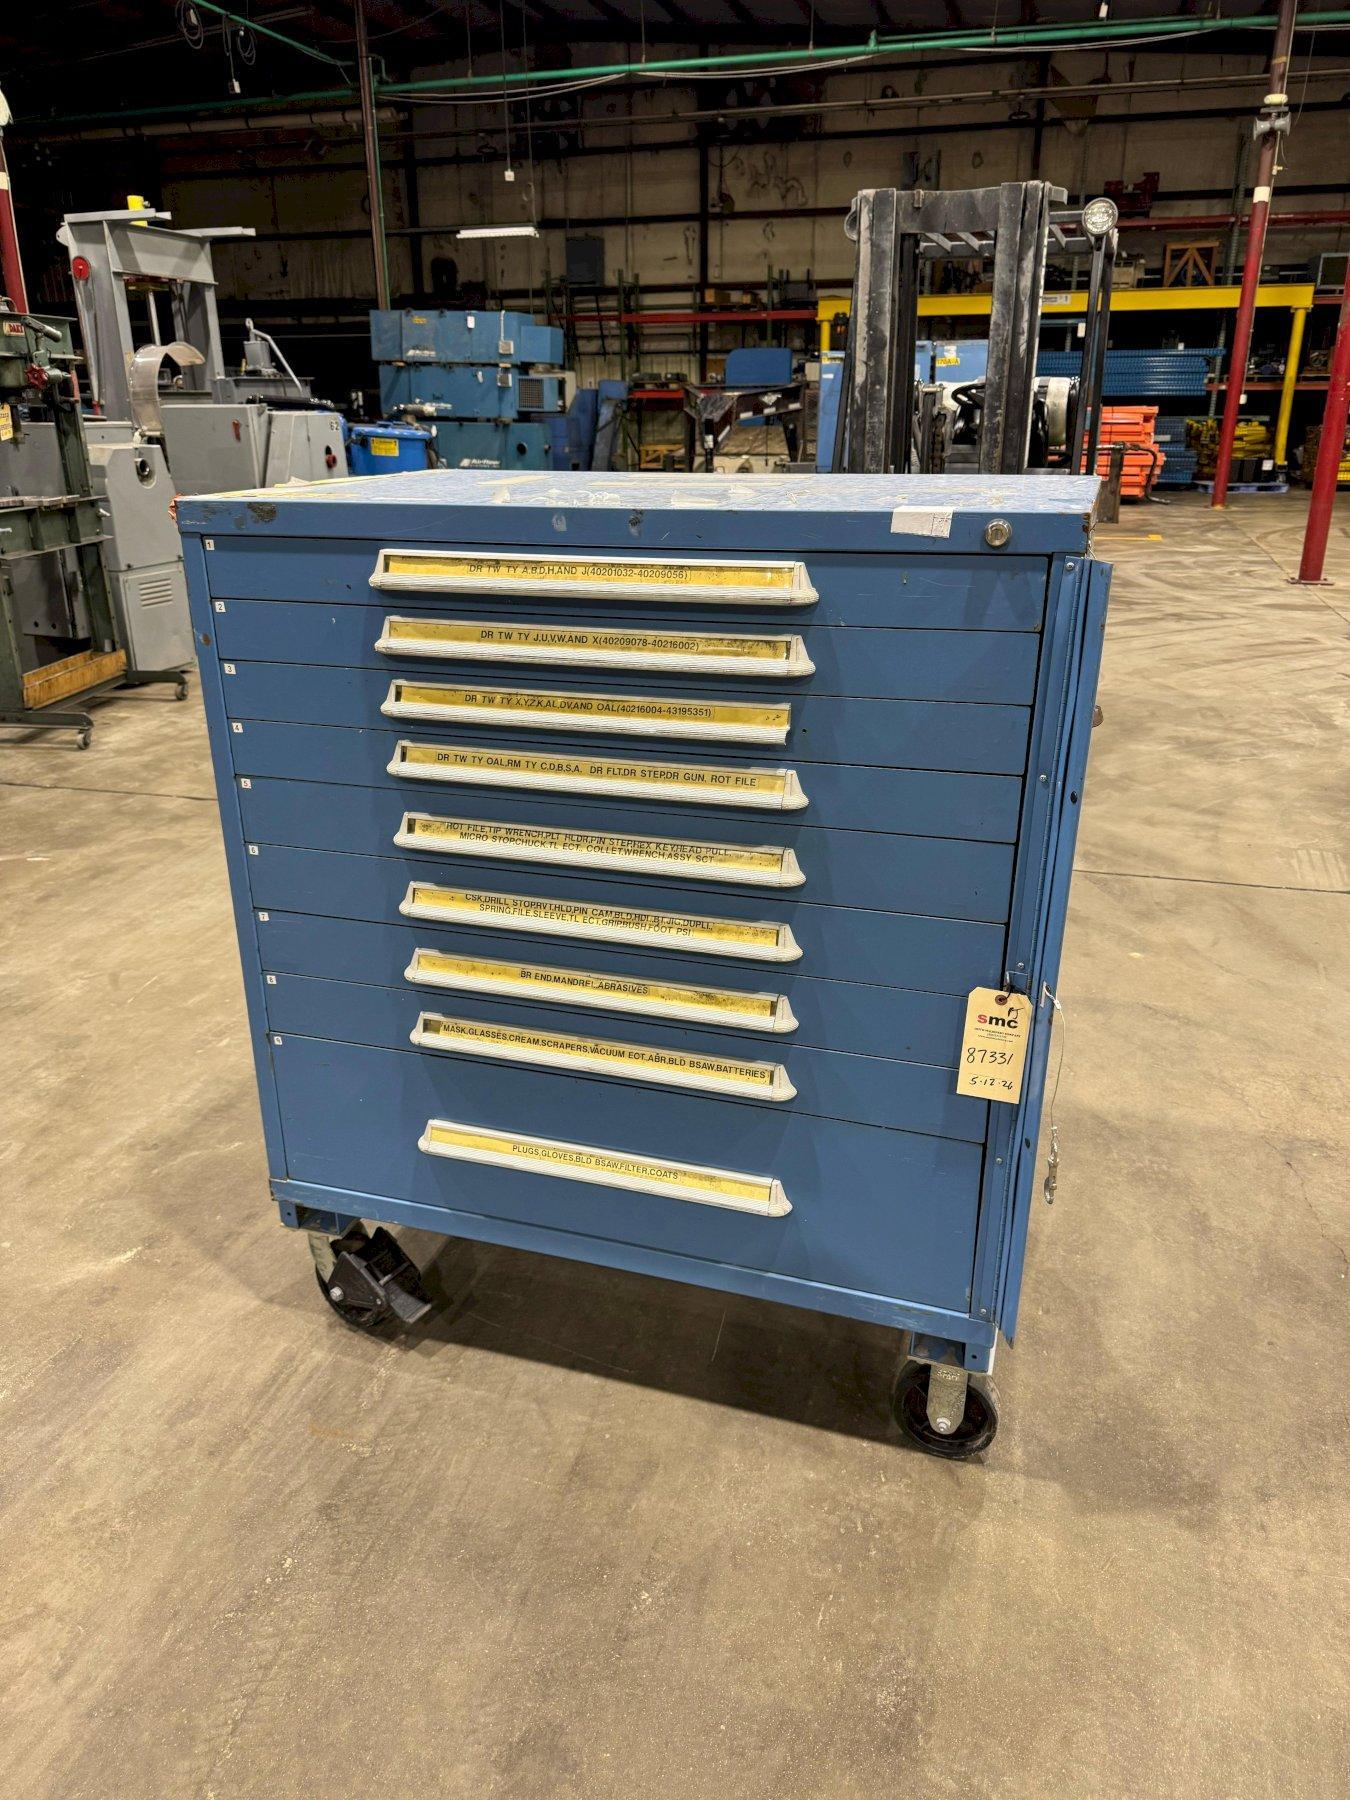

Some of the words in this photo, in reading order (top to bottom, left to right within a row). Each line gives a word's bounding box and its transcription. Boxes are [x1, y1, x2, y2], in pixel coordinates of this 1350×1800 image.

[469, 564, 483, 573] DR
[487, 565, 501, 574] TW
[506, 565, 519, 574] TY
[480, 630, 494, 639] DR
[498, 631, 513, 640] TW
[517, 632, 530, 641] TY
[464, 694, 477, 703] DR
[481, 695, 496, 704] TW
[499, 696, 513, 705] TY
[437, 753, 450, 762] DR
[453, 754, 468, 763] TW
[471, 755, 484, 764] TY
[525, 760, 538, 769] TY
[589, 765, 603, 775] DR
[710, 774, 732, 784] ROT
[735, 776, 757, 787] FILE
[445, 821, 464, 831] ROT
[459, 831, 489, 841] MICRO
[520, 970, 532, 979] BR
[976, 1014, 1019, 1029] smc
[966, 1047, 1014, 1065] 87331
